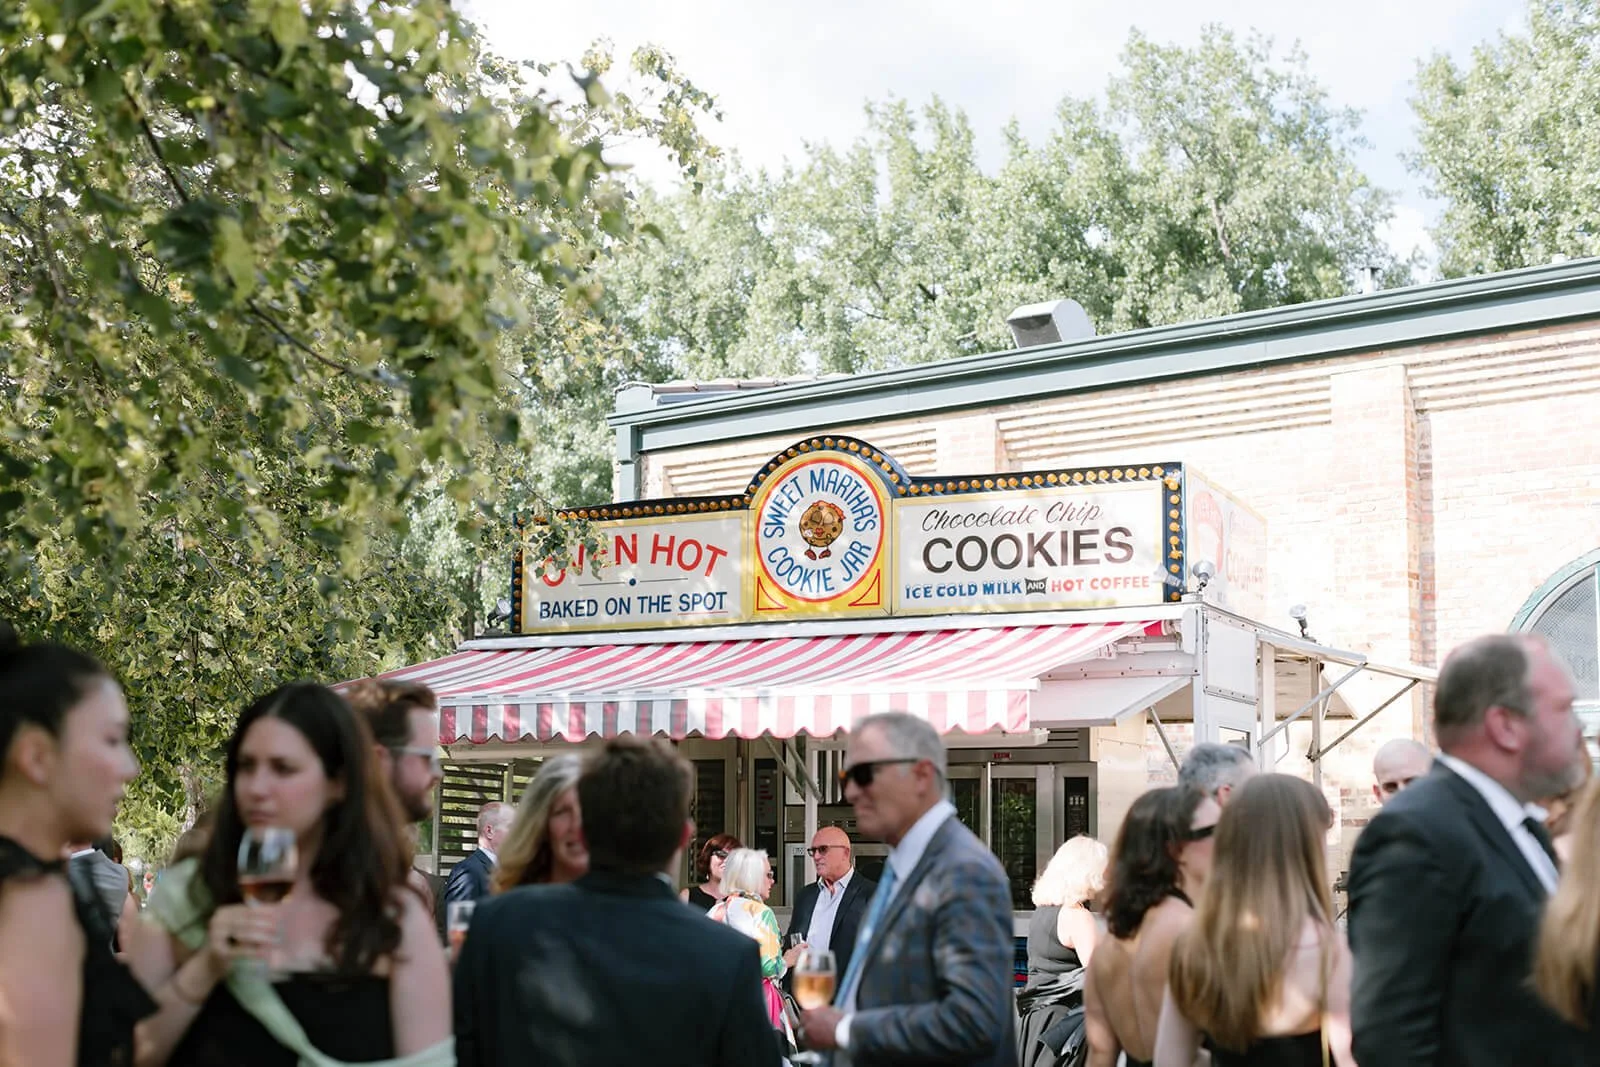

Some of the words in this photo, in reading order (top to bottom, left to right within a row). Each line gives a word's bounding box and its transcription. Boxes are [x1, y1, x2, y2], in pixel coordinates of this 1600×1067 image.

[764, 475, 805, 539] SWEET
[921, 504, 1039, 532] Chocolate
[1046, 501, 1100, 526] Chip
[650, 532, 728, 577] HOT
[767, 546, 836, 593] COOKIE
[839, 540, 872, 582] JAR
[922, 526, 1135, 573] COOKIES
[539, 598, 599, 620] BAKED
[604, 596, 632, 616] ON
[637, 594, 673, 614] THE
[678, 591, 728, 612] SPOT
[905, 584, 933, 600] ICE
[936, 582, 979, 598] COLD
[982, 579, 1023, 596] MILK
[1026, 582, 1046, 591] AND
[1051, 578, 1085, 593] HOT
[1090, 575, 1150, 591] COFFEE
